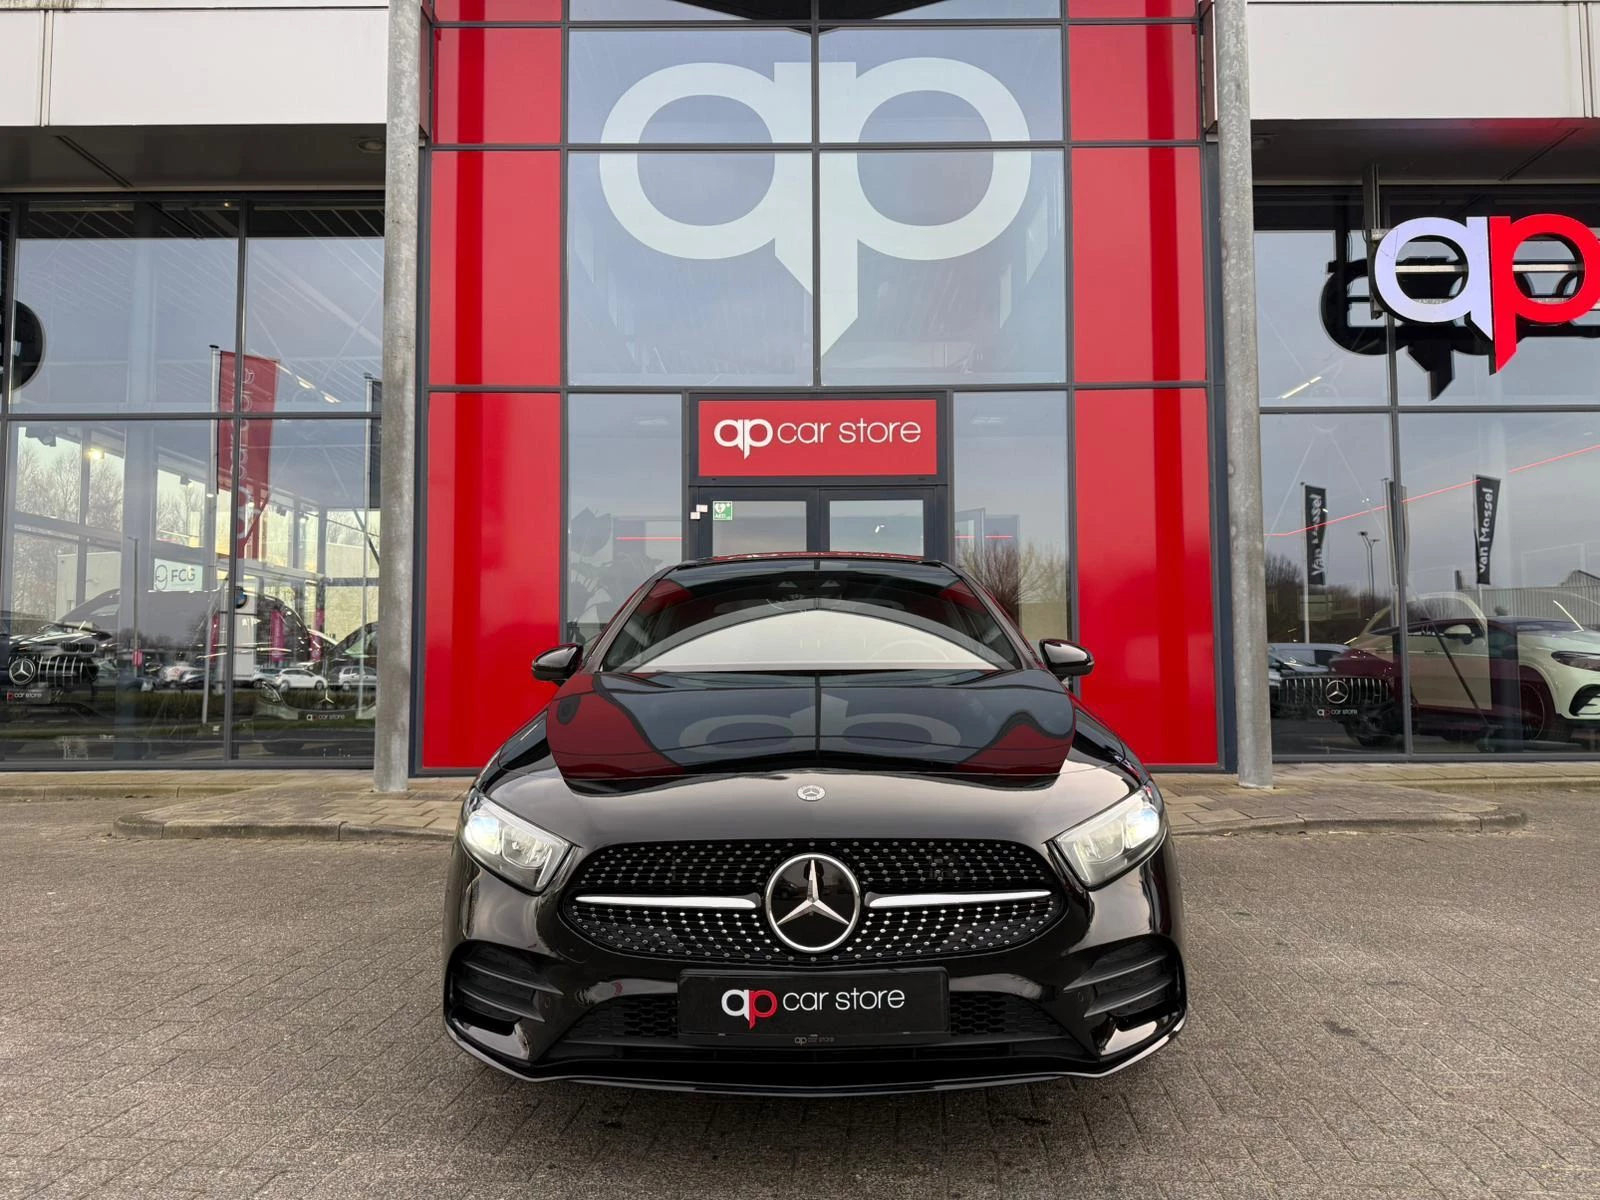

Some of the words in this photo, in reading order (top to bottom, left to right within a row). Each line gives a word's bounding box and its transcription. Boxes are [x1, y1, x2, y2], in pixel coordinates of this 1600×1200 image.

[714, 418, 773, 460] ap
[777, 422, 832, 444] car
[838, 418, 921, 444] store
[1480, 487, 1494, 542] Mossel
[171, 568, 196, 582] FCG
[721, 989, 778, 1030] ap
[783, 992, 829, 1011] car
[835, 987, 905, 1011] store
